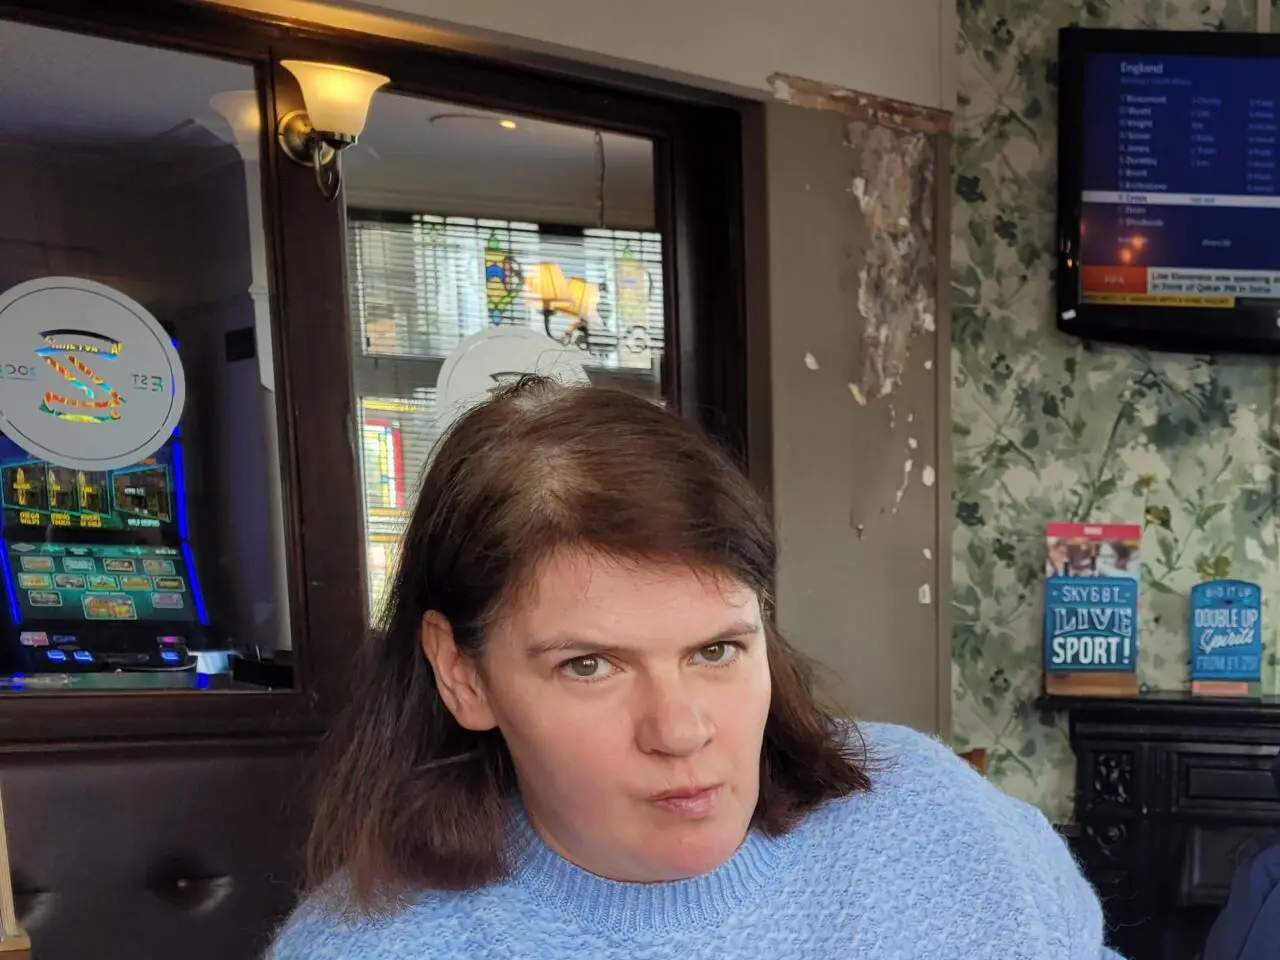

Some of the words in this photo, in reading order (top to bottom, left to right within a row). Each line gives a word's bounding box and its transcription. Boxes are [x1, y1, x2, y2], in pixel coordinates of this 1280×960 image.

[1120, 62, 1163, 75] England
[1053, 607, 1132, 638] LIVE
[1194, 608, 1239, 628] DOUBLE
[1241, 608, 1258, 628] UP
